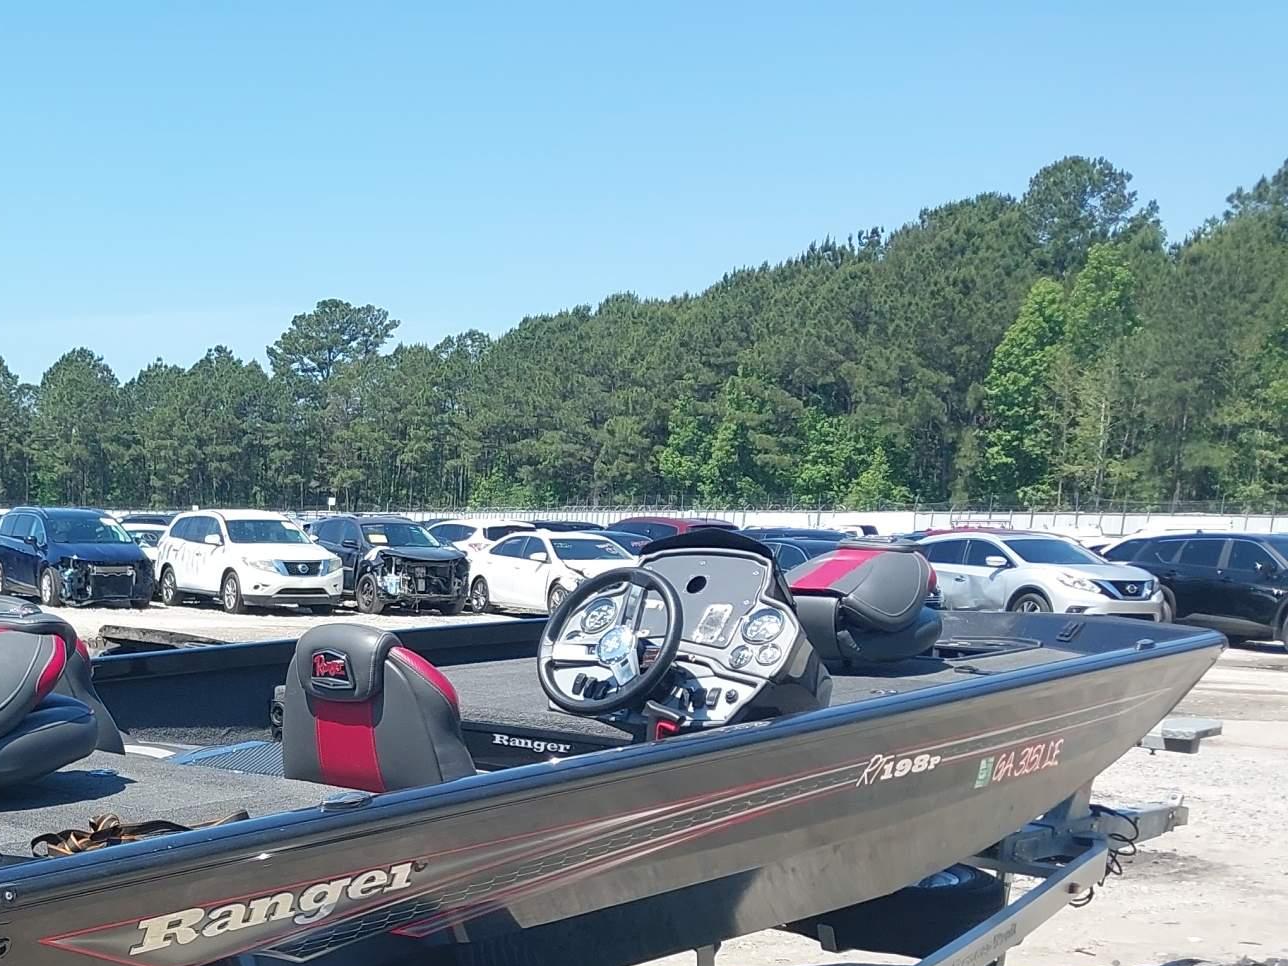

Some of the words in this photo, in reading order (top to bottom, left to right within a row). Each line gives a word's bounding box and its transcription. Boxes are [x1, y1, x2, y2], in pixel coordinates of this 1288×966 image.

[492, 733, 571, 753] Ranger
[992, 751, 1015, 782] GA
[128, 860, 415, 956] Ranger
